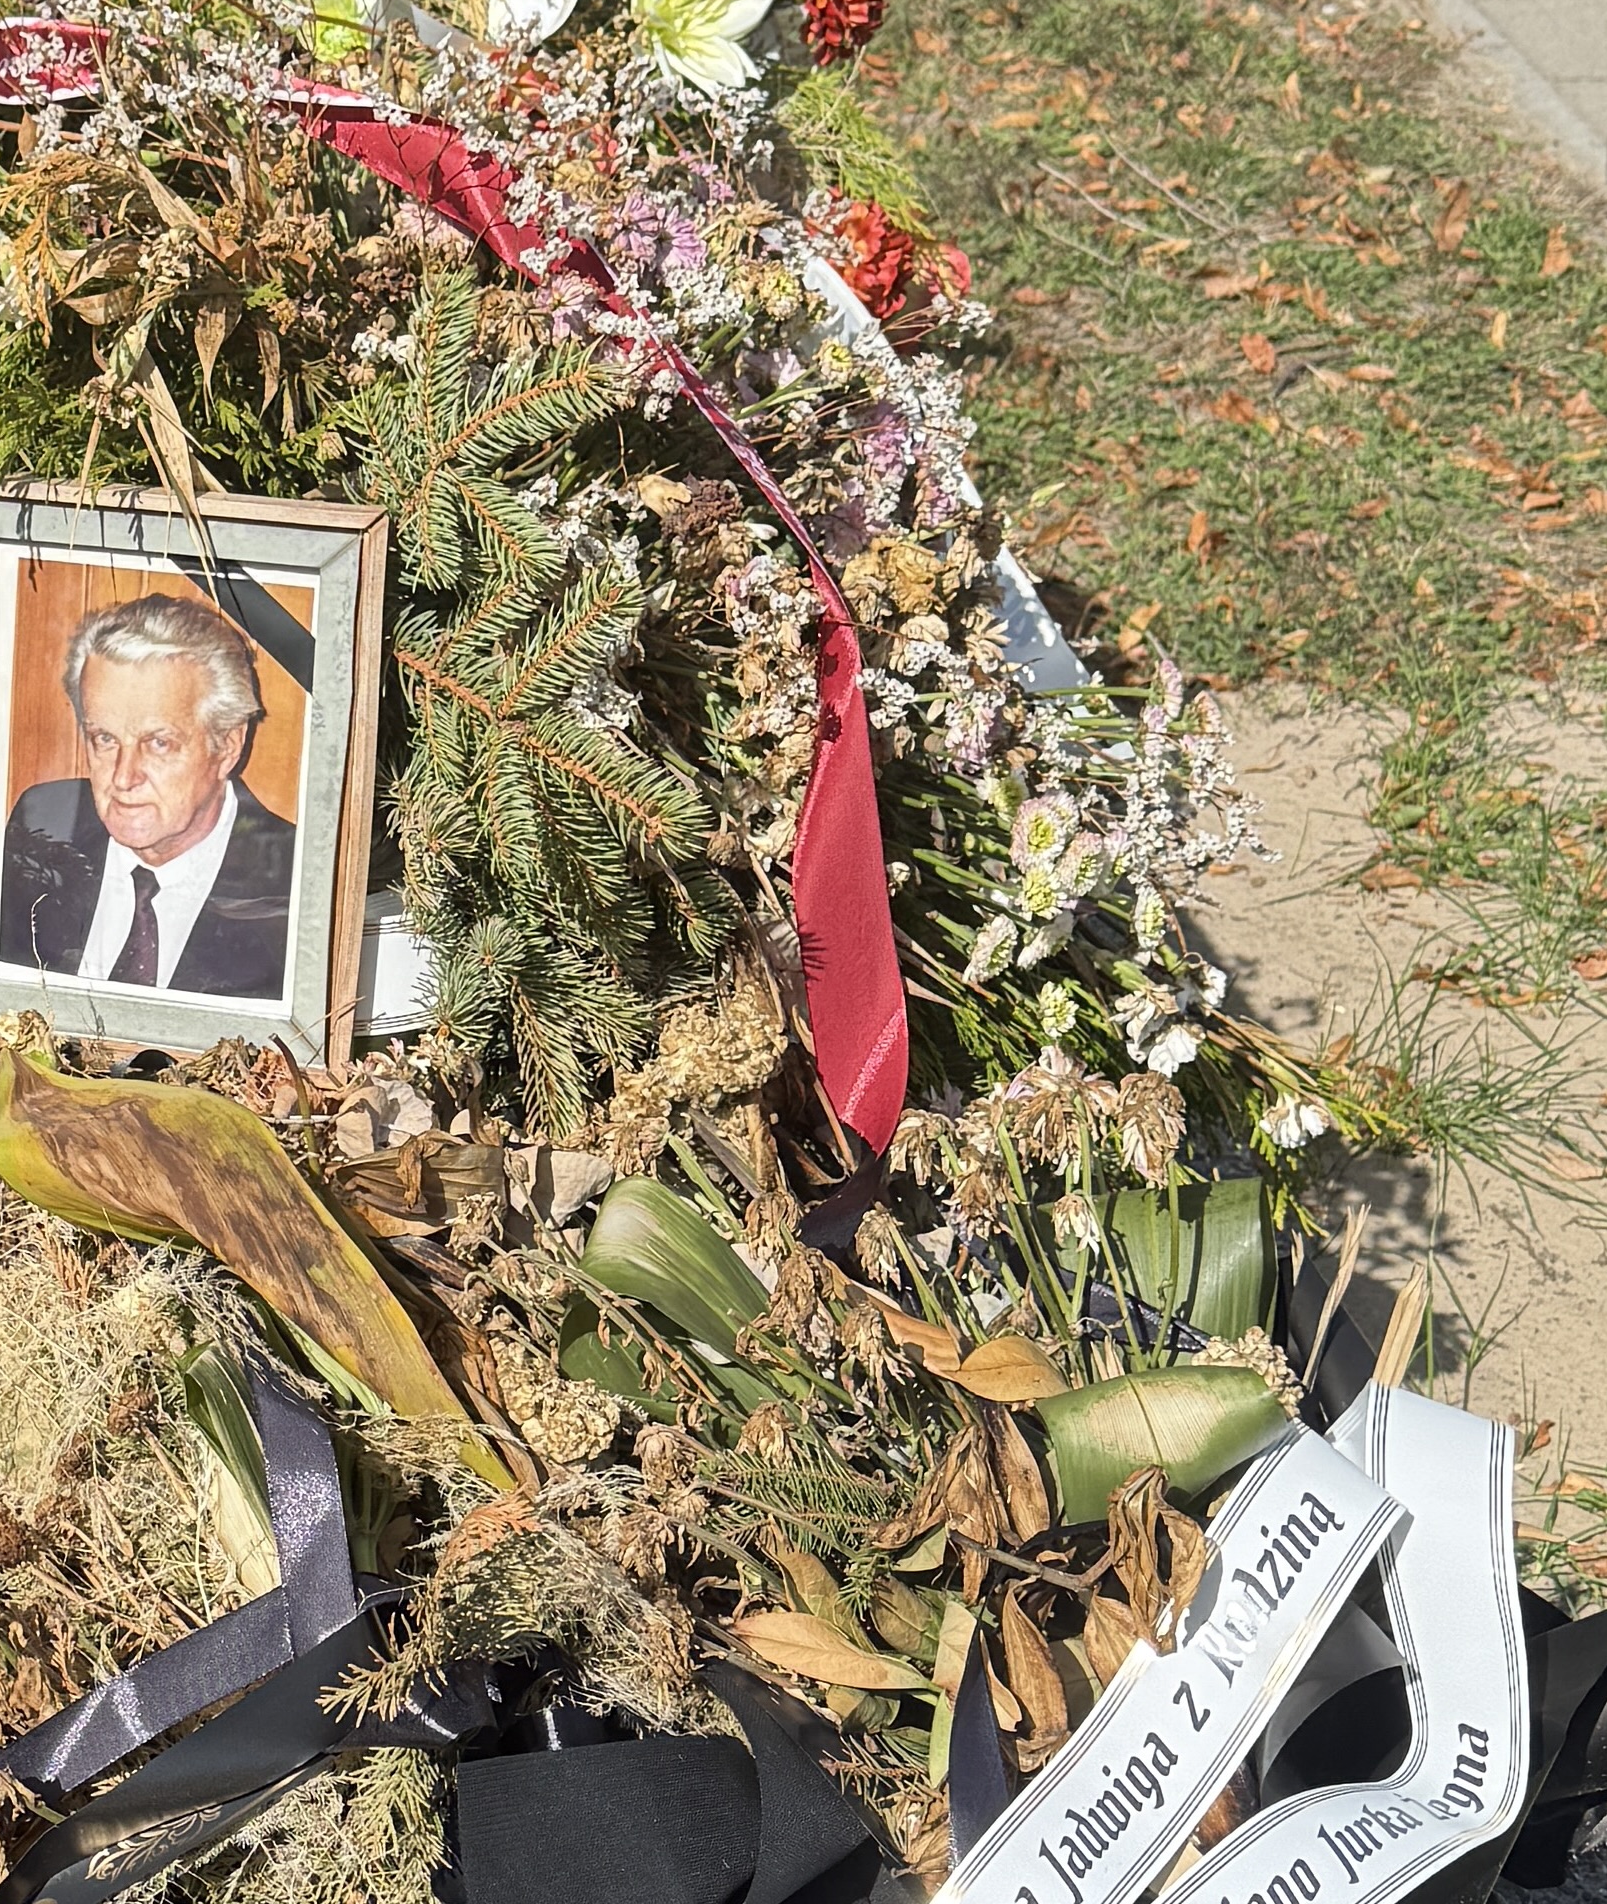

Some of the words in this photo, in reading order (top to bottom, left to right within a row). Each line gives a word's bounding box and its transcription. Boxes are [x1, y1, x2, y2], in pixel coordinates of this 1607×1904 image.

[1038, 1730, 1179, 1904] Jadwiga
[1172, 1680, 1211, 1732] z
[1317, 1804, 1423, 1884] Jurka
